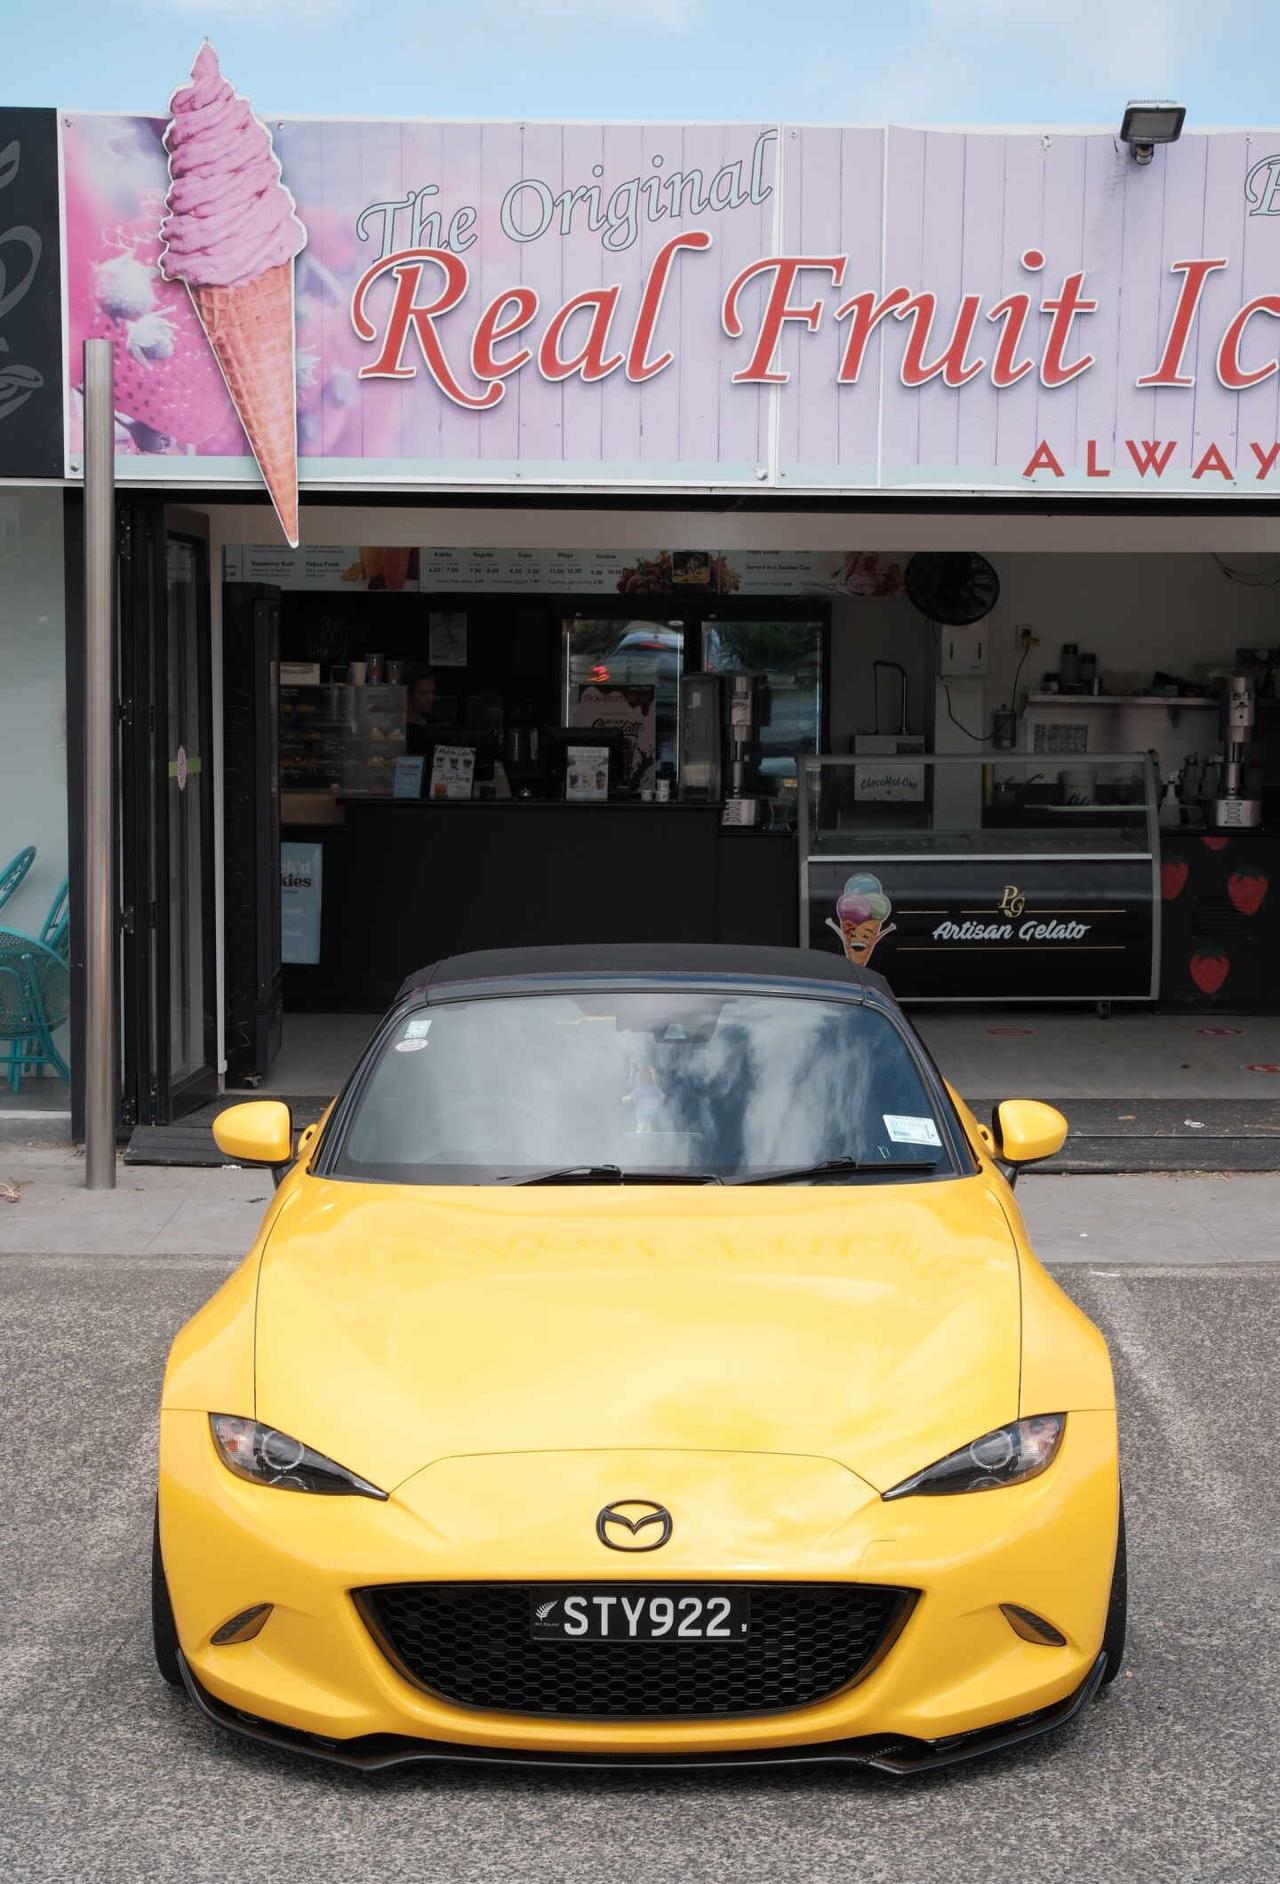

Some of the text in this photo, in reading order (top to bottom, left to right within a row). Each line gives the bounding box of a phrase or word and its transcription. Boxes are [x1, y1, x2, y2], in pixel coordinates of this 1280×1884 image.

[356, 129, 778, 263] The Original
[351, 230, 712, 409] Real
[721, 249, 1098, 389] Fruit
[1022, 440, 1280, 481] ALWAY
[932, 919, 1092, 941] Artisan Gelato
[564, 1596, 731, 1637] STY922
